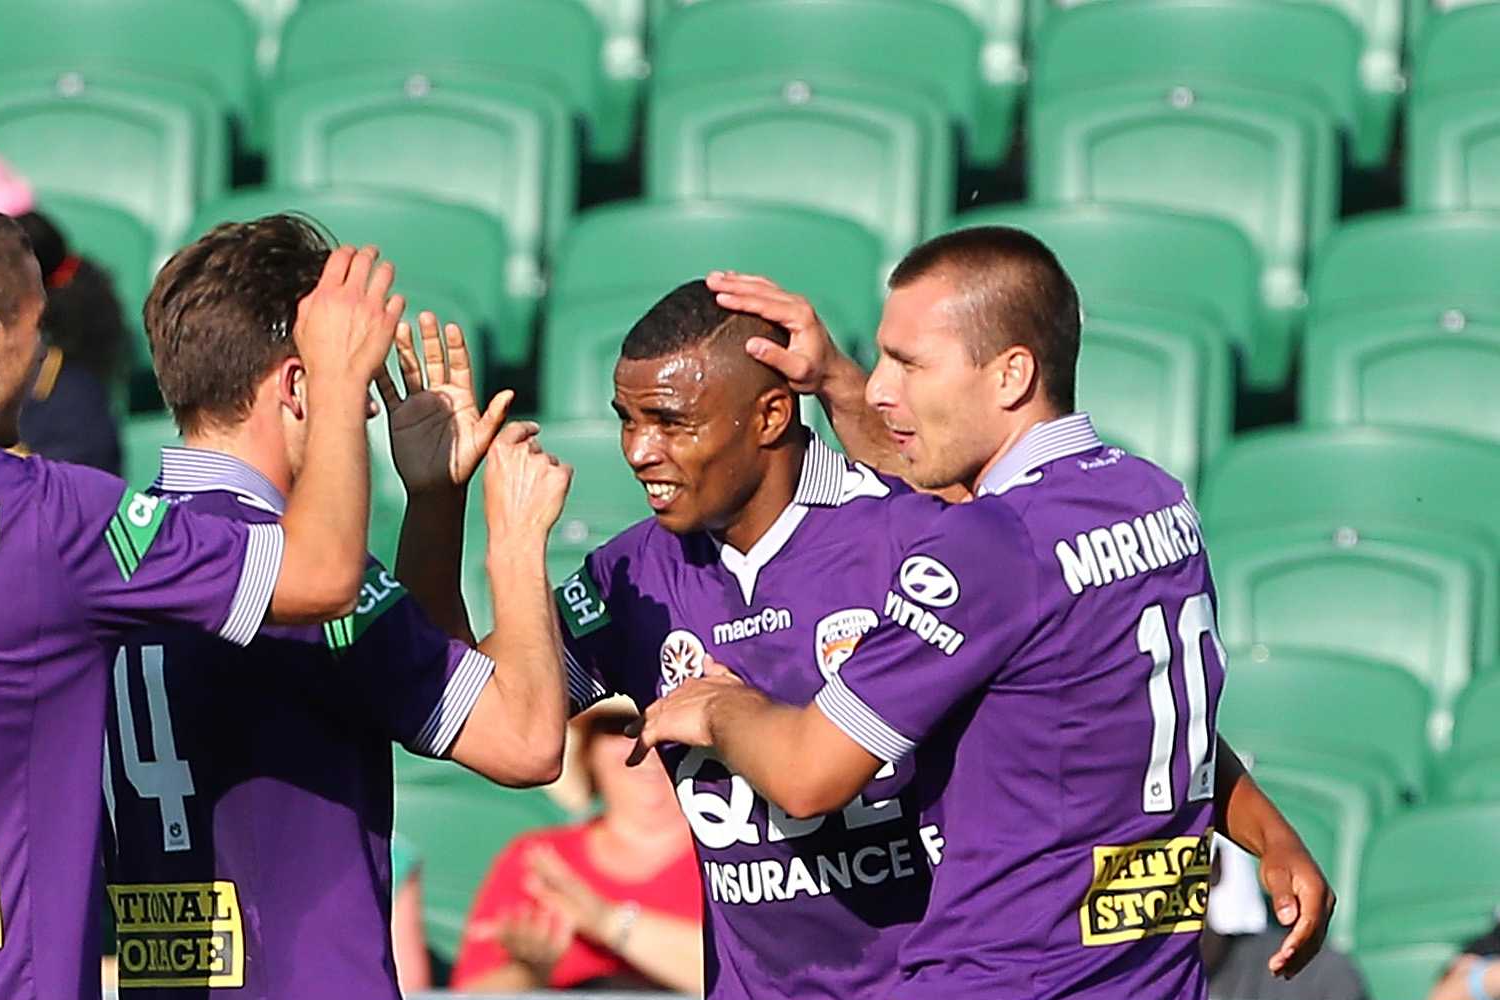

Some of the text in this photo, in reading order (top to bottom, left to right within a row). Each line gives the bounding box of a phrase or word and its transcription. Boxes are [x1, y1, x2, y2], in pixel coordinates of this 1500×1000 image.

[1055, 499, 1200, 595] MARINKO
[563, 573, 601, 627] GH
[713, 608, 792, 645] macron
[102, 645, 196, 851] 4
